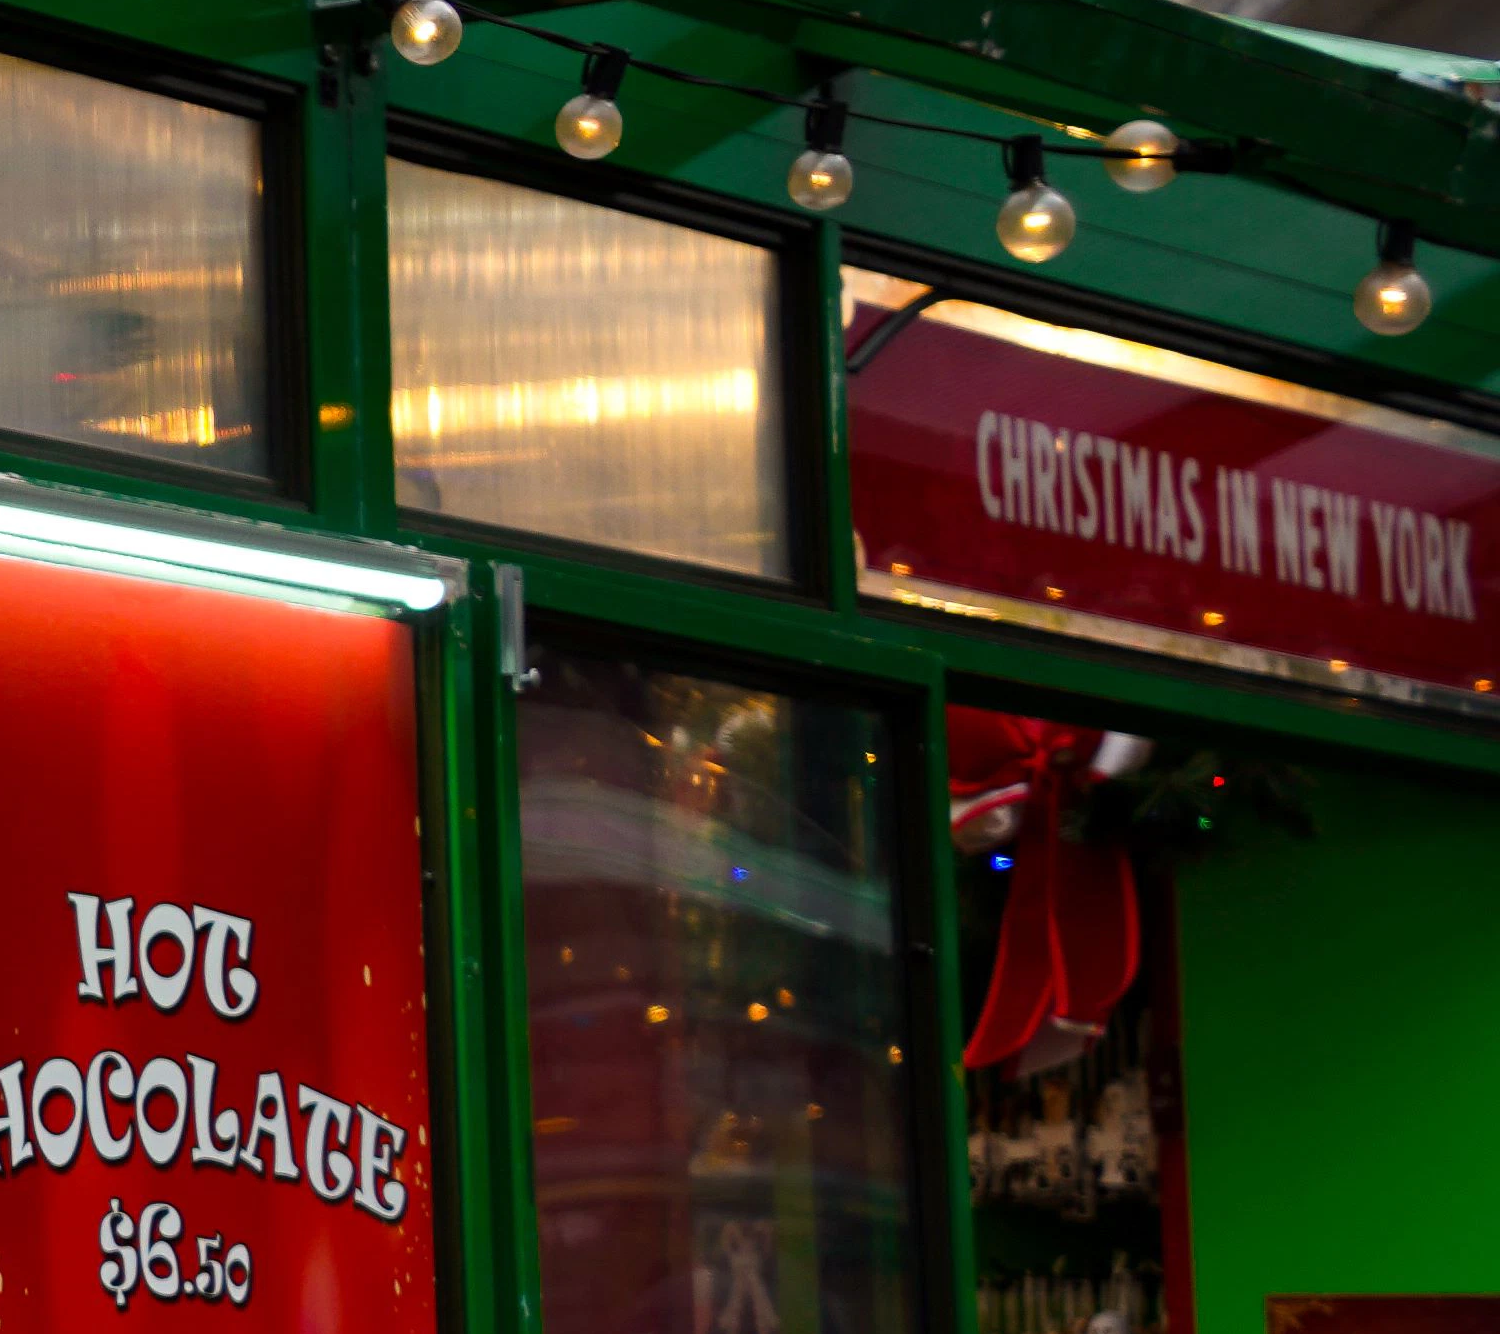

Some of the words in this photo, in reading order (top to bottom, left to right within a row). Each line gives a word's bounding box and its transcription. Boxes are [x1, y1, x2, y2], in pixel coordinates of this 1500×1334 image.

[976, 410, 1202, 563] CHRISTMAS
[1217, 466, 1261, 576] IN
[1272, 476, 1359, 599] NEW
[1372, 500, 1475, 622] YORK
[67, 892, 257, 1017] HOT
[100, 1198, 251, 1305] $6.50
